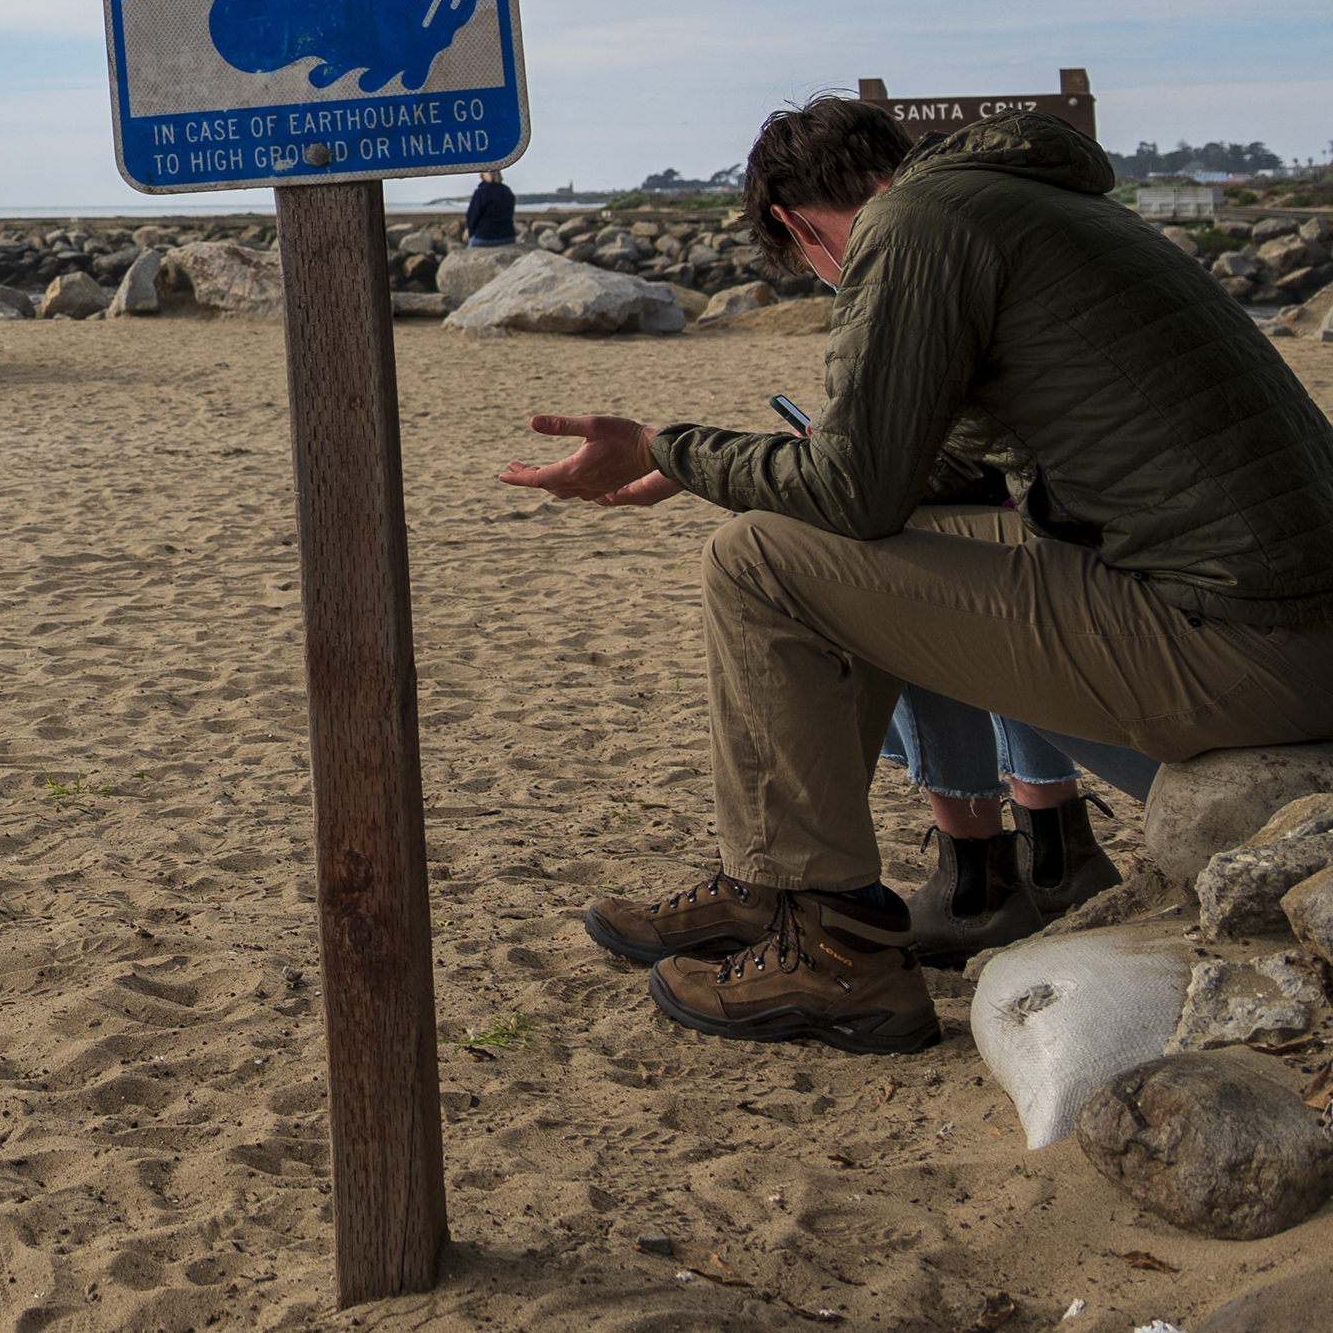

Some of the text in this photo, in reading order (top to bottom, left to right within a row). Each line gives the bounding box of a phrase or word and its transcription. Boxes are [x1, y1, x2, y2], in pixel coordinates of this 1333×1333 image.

[154, 98, 484, 146] IN CASE OF EARTHQUAKE GO
[893, 102, 964, 121] SANTA
[153, 153, 179, 175] TO
[191, 148, 243, 173] HIGH
[359, 138, 391, 160] OR
[401, 129, 489, 157] INLAND
